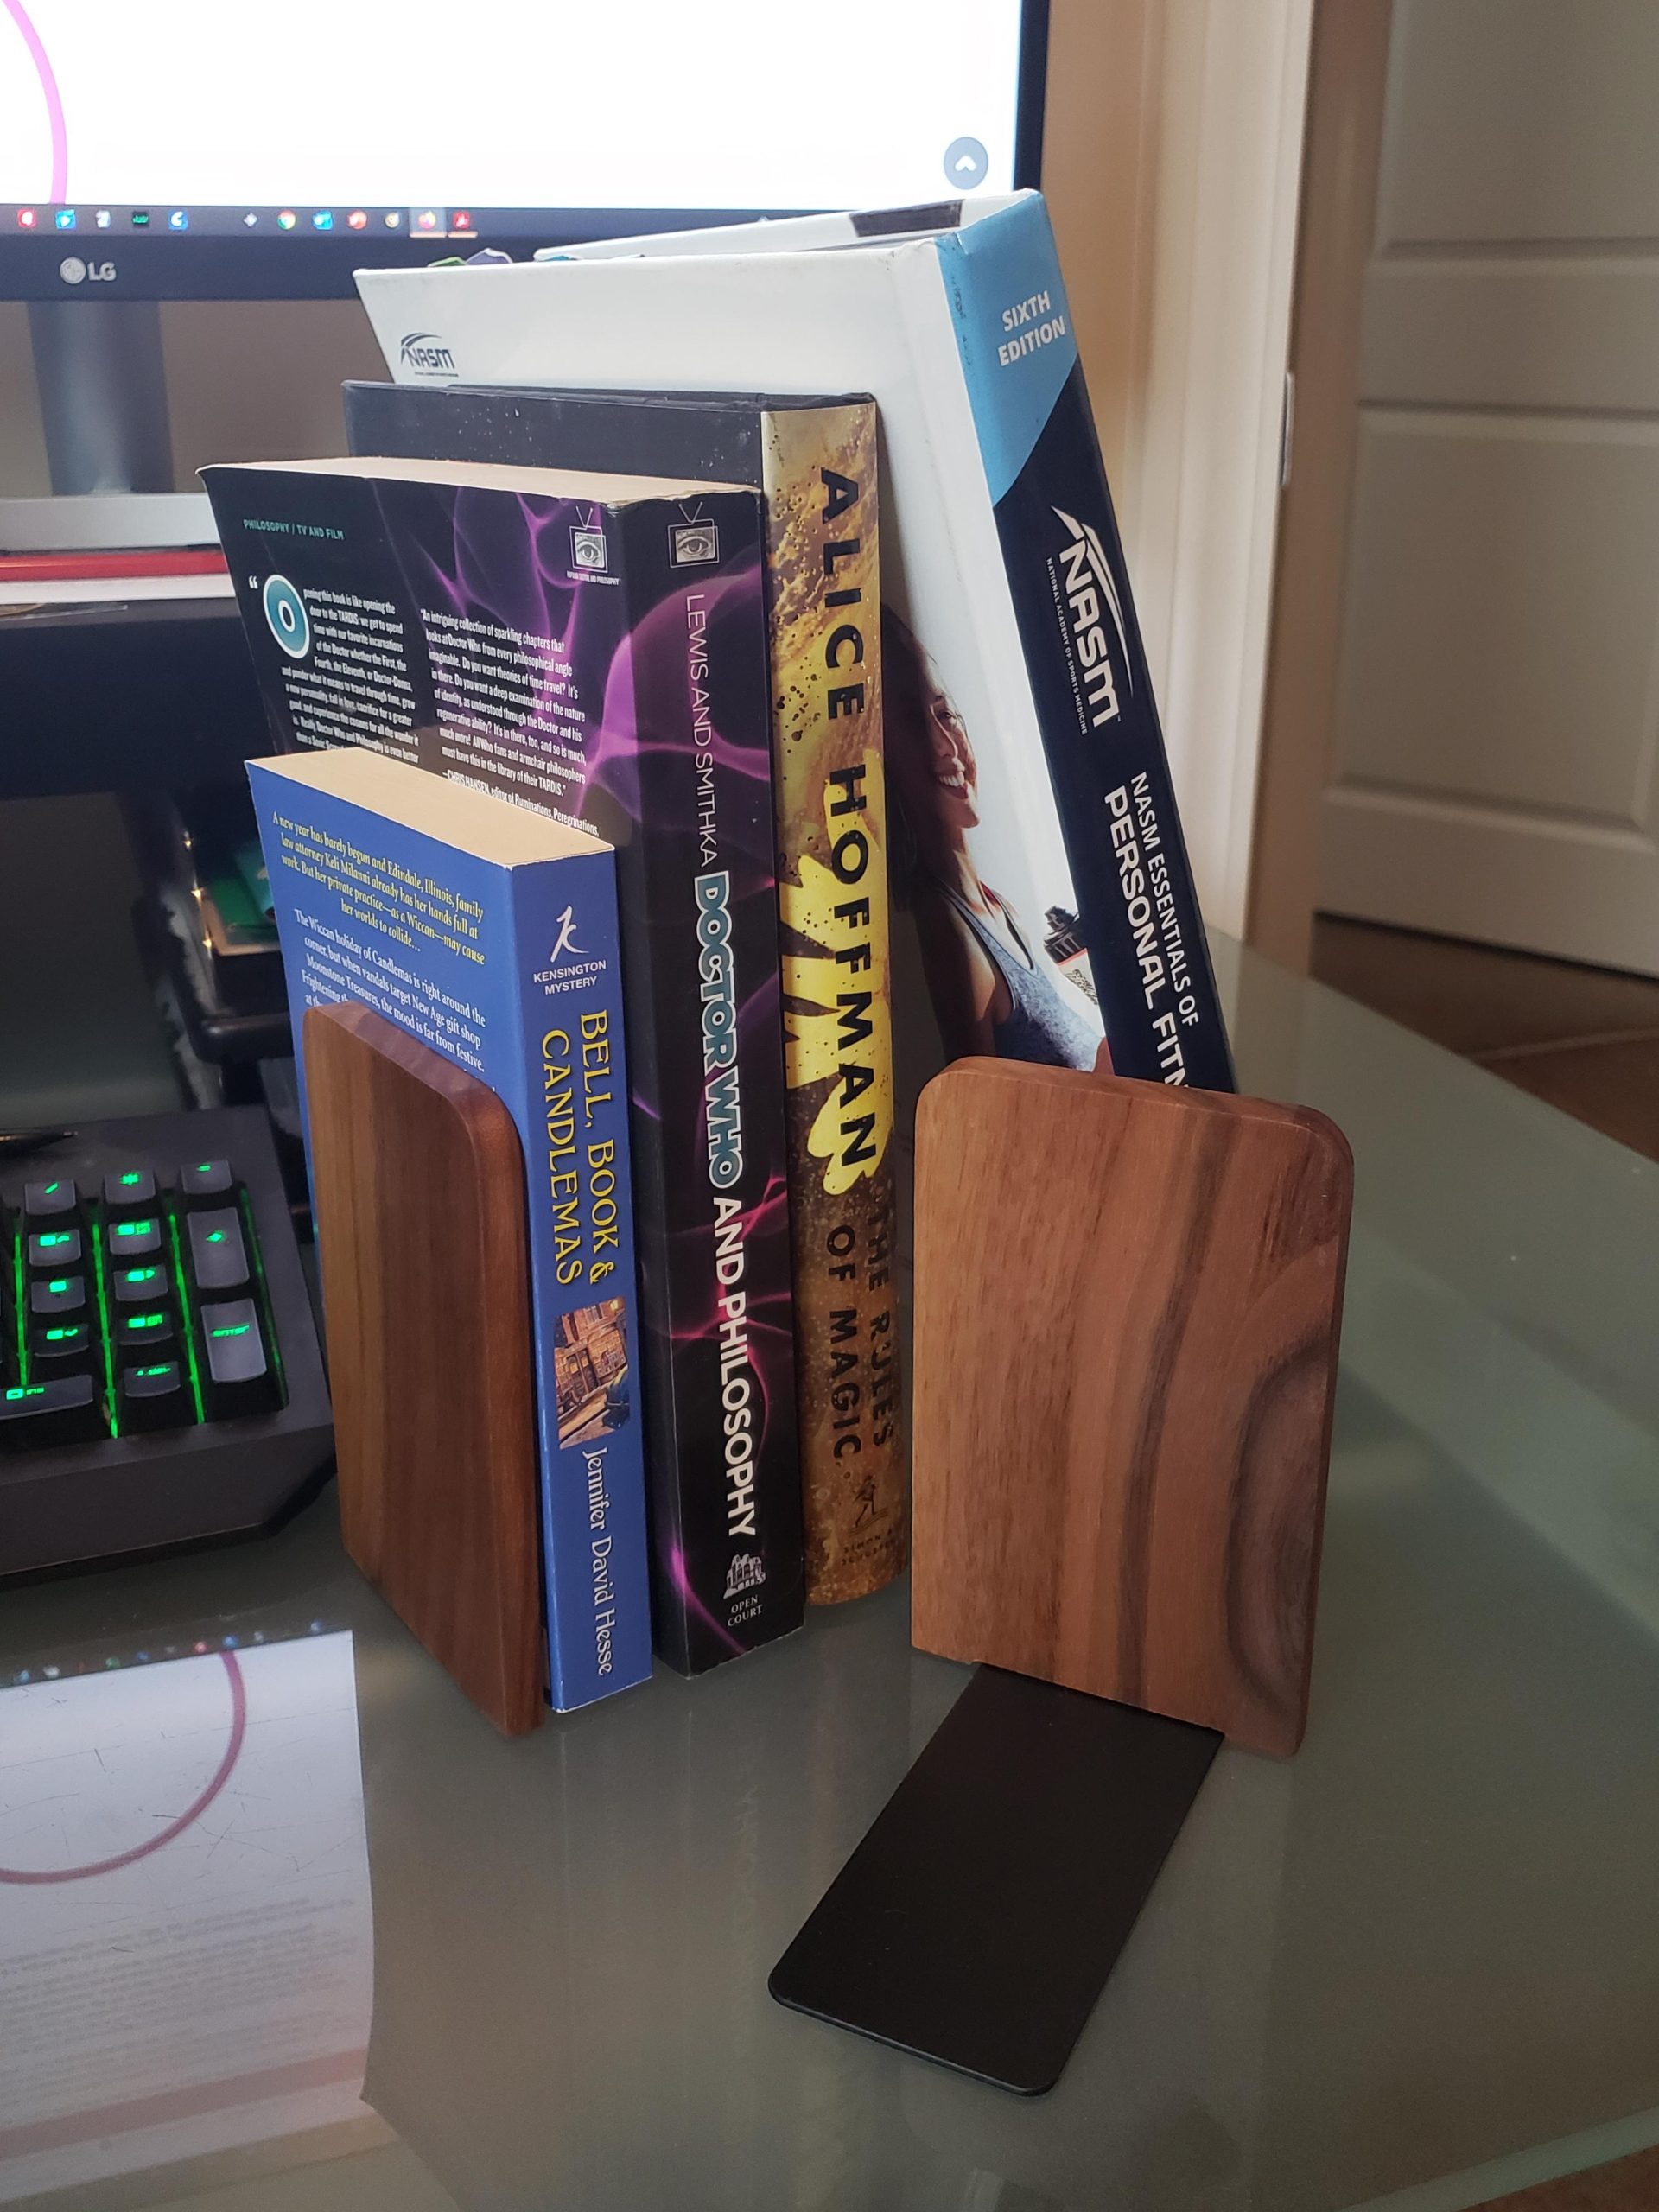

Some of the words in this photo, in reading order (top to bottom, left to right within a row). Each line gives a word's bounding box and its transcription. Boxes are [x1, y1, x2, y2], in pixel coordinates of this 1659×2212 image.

[88, 262, 117, 281] LG
[1002, 290, 1051, 332] SIXTH
[404, 347, 454, 369] NASM
[998, 315, 1065, 366] EDITION
[244, 519, 289, 533] PHILOSOPHY
[296, 524, 306, 536] TV
[309, 528, 324, 538] AND
[326, 529, 345, 540] FILM
[687, 594, 709, 681] LEWIS
[821, 467, 864, 720] ALICE
[1059, 539, 1120, 728] NASM
[1046, 557, 1059, 603] NATIONAL
[1056, 604, 1069, 645] ACADEMY
[1065, 647, 1071, 658] OF
[1068, 659, 1079, 693] SPORTS
[1075, 693, 1087, 735] MEDICINE
[692, 686, 712, 747] AND
[696, 752, 718, 868] SMITHKA
[279, 816, 294, 830] new
[294, 821, 309, 837] year
[310, 826, 323, 843] has
[324, 831, 346, 858] barely
[347, 842, 371, 865] begun
[372, 852, 386, 873] and
[454, 893, 484, 925] family
[281, 832, 294, 849] law
[295, 841, 325, 867] attorney
[325, 853, 340, 873] Keli
[340, 859, 370, 886] Milanni
[372, 873, 399, 903] already
[399, 886, 414, 907] has
[415, 895, 428, 913] her
[429, 904, 453, 927] hands
[453, 915, 468, 938] full
[469, 926, 479, 940] at
[302, 861, 315, 877] But
[315, 867, 327, 883] her
[327, 873, 353, 898] private
[401, 912, 406, 924] a
[462, 944, 486, 966] cause
[340, 898, 353, 916] her
[355, 907, 379, 930] worlds
[379, 918, 387, 933] to
[1104, 785, 1165, 1010] PERSONAL
[1130, 771, 1160, 852] NASM
[1148, 852, 1191, 993] ESSENTIALS
[1179, 994, 1199, 1027] OF
[294, 909, 309, 926] The
[308, 915, 335, 942] Wiccan
[335, 927, 363, 959] holiday
[363, 944, 372, 961] of
[372, 950, 413, 985] Candlemas
[413, 971, 421, 990] is
[421, 978, 441, 1003] right
[442, 992, 471, 1014] around
[472, 1006, 486, 1028] the
[306, 953, 346, 986] Moonstone
[381, 995, 393, 1016] the
[394, 1009, 416, 1030] mood
[416, 1016, 423, 1033] is
[423, 1022, 435, 1043] far
[435, 1029, 455, 1054] from
[328, 944, 340, 963] but
[341, 955, 361, 976] when
[362, 967, 389, 993] vandals
[390, 981, 411, 1007] target
[411, 992, 429, 1015] New
[430, 1007, 445, 1028] Age
[446, 1014, 460, 1035] gift
[461, 1025, 481, 1050] shop
[533, 959, 607, 983] KENSINGTON
[544, 976, 597, 995] MYSTERY
[694, 870, 739, 1077] DOCTOR
[830, 763, 877, 1168] HOFFMAN
[580, 1009, 612, 1128] BELL,
[542, 1029, 582, 1285] CANDLEMAS
[705, 1065, 743, 1189] WHO
[588, 1139, 619, 1254] BOOK
[713, 1196, 744, 1285] AND
[589, 1261, 615, 1285] &
[827, 1224, 855, 1282] OF
[868, 1208, 889, 1291] THE
[718, 1291, 756, 1537] PHILOSOPHY
[830, 1309, 861, 1459] MAGIC
[870, 1310, 893, 1446] RULES
[582, 1447, 608, 1531] Jennifer
[590, 1535, 615, 1605] David
[727, 1604, 763, 1628] COURT
[730, 1593, 759, 1614] OPEN
[593, 1607, 615, 1677] Hesse
